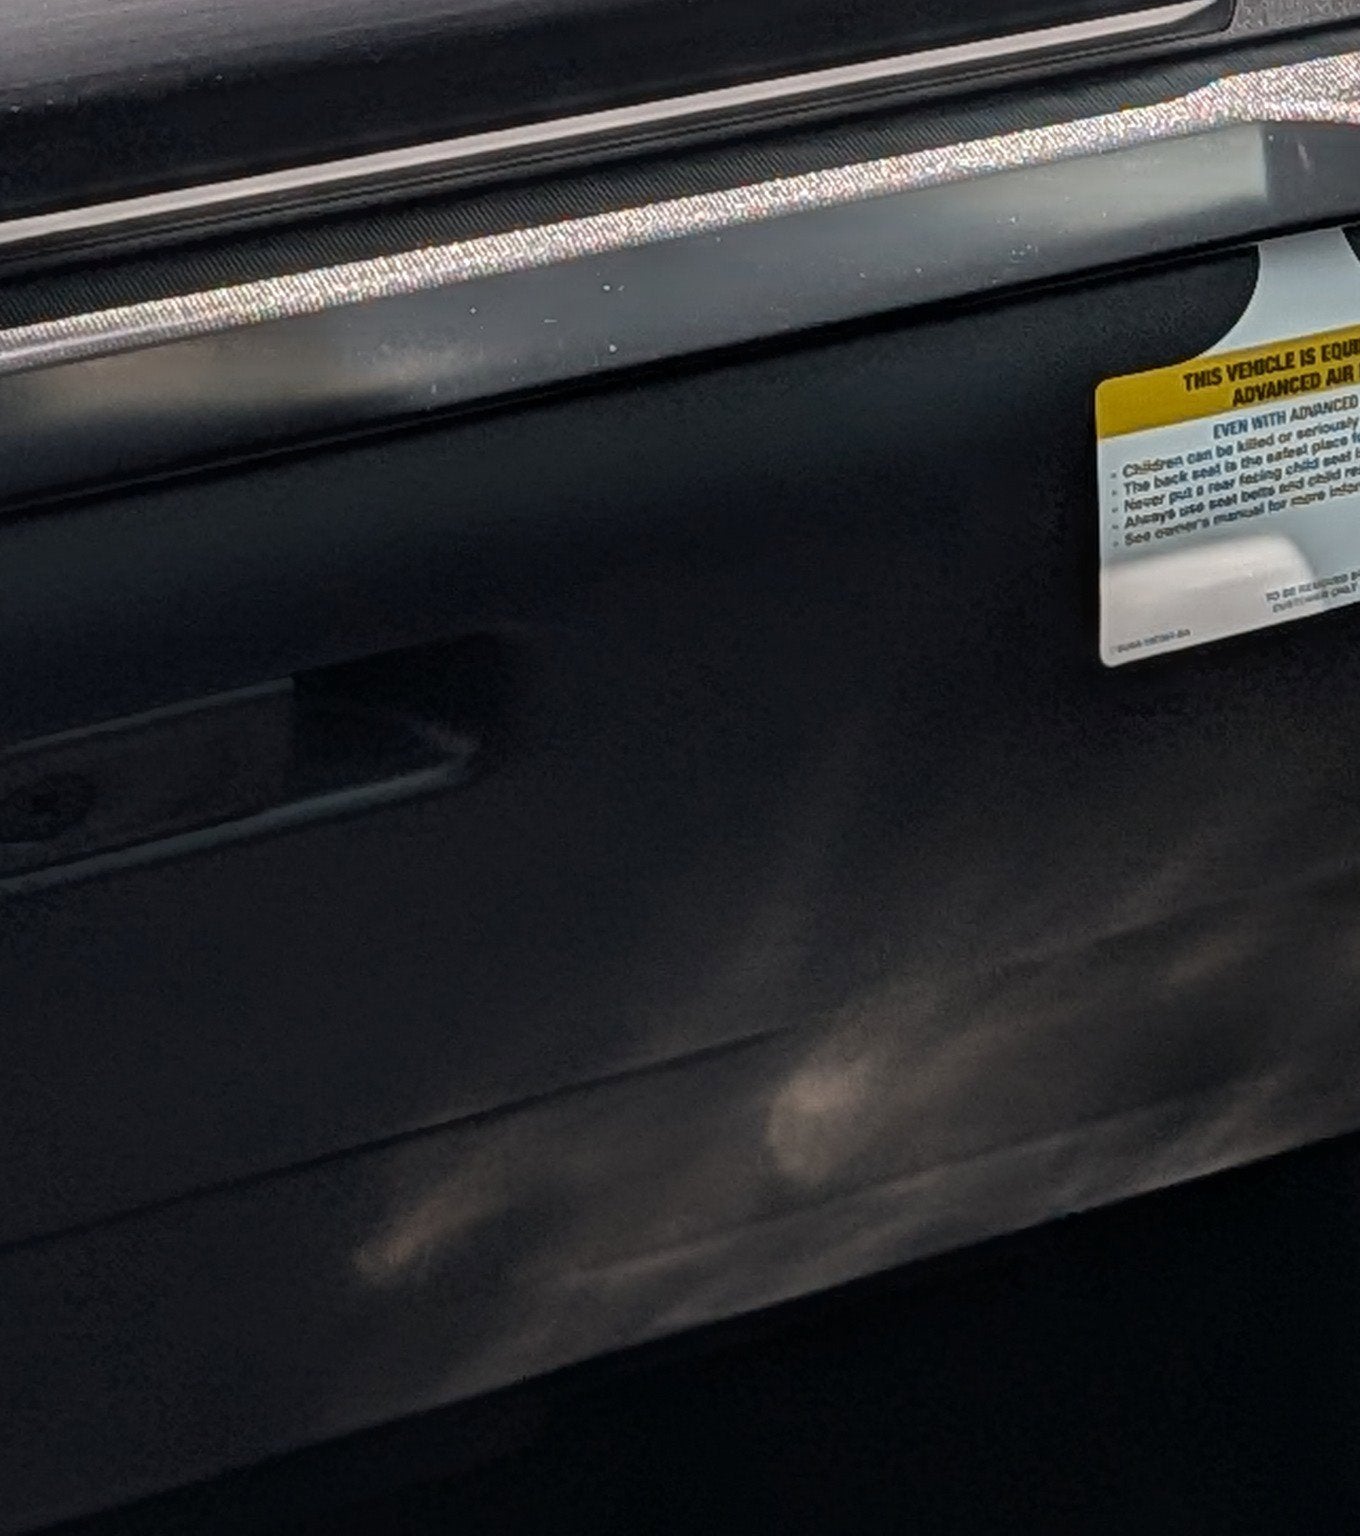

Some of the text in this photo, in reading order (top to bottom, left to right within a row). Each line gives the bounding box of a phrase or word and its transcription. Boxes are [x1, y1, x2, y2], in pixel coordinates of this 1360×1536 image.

[1183, 369, 1223, 392] THIS
[1226, 351, 1295, 382] VEHICLE
[1299, 347, 1316, 367] IS
[1232, 372, 1321, 407] ADVANCED
[1325, 366, 1354, 387] AIR
[1213, 420, 1248, 440] EVEN
[1251, 413, 1286, 432] WITH
[1289, 394, 1358, 422] ADVANCED
[1122, 454, 1184, 478] Children
[1186, 449, 1212, 464] can
[1215, 443, 1233, 457] be
[1236, 433, 1275, 453] killed
[1278, 432, 1292, 444] or
[1296, 416, 1358, 442] seriously
[1123, 479, 1150, 495] The
[1154, 470, 1188, 489] back
[1191, 464, 1222, 481] seat
[1225, 462, 1237, 473] is
[1240, 453, 1263, 470] the
[1266, 443, 1309, 464] safest
[1311, 436, 1348, 458] place
[1124, 493, 1165, 513] Never
[1168, 488, 1193, 504] put
[1208, 478, 1235, 494] rear
[1238, 467, 1282, 487] facing
[1285, 457, 1319, 476] child
[1323, 451, 1352, 467] seat
[1124, 507, 1176, 530] Always
[1179, 503, 1204, 518] use
[1208, 492, 1238, 509] seat
[1279, 477, 1304, 494] and
[1307, 467, 1341, 488] child
[1124, 530, 1150, 547] See
[1213, 503, 1265, 526] manual
[1268, 496, 1287, 512] for
